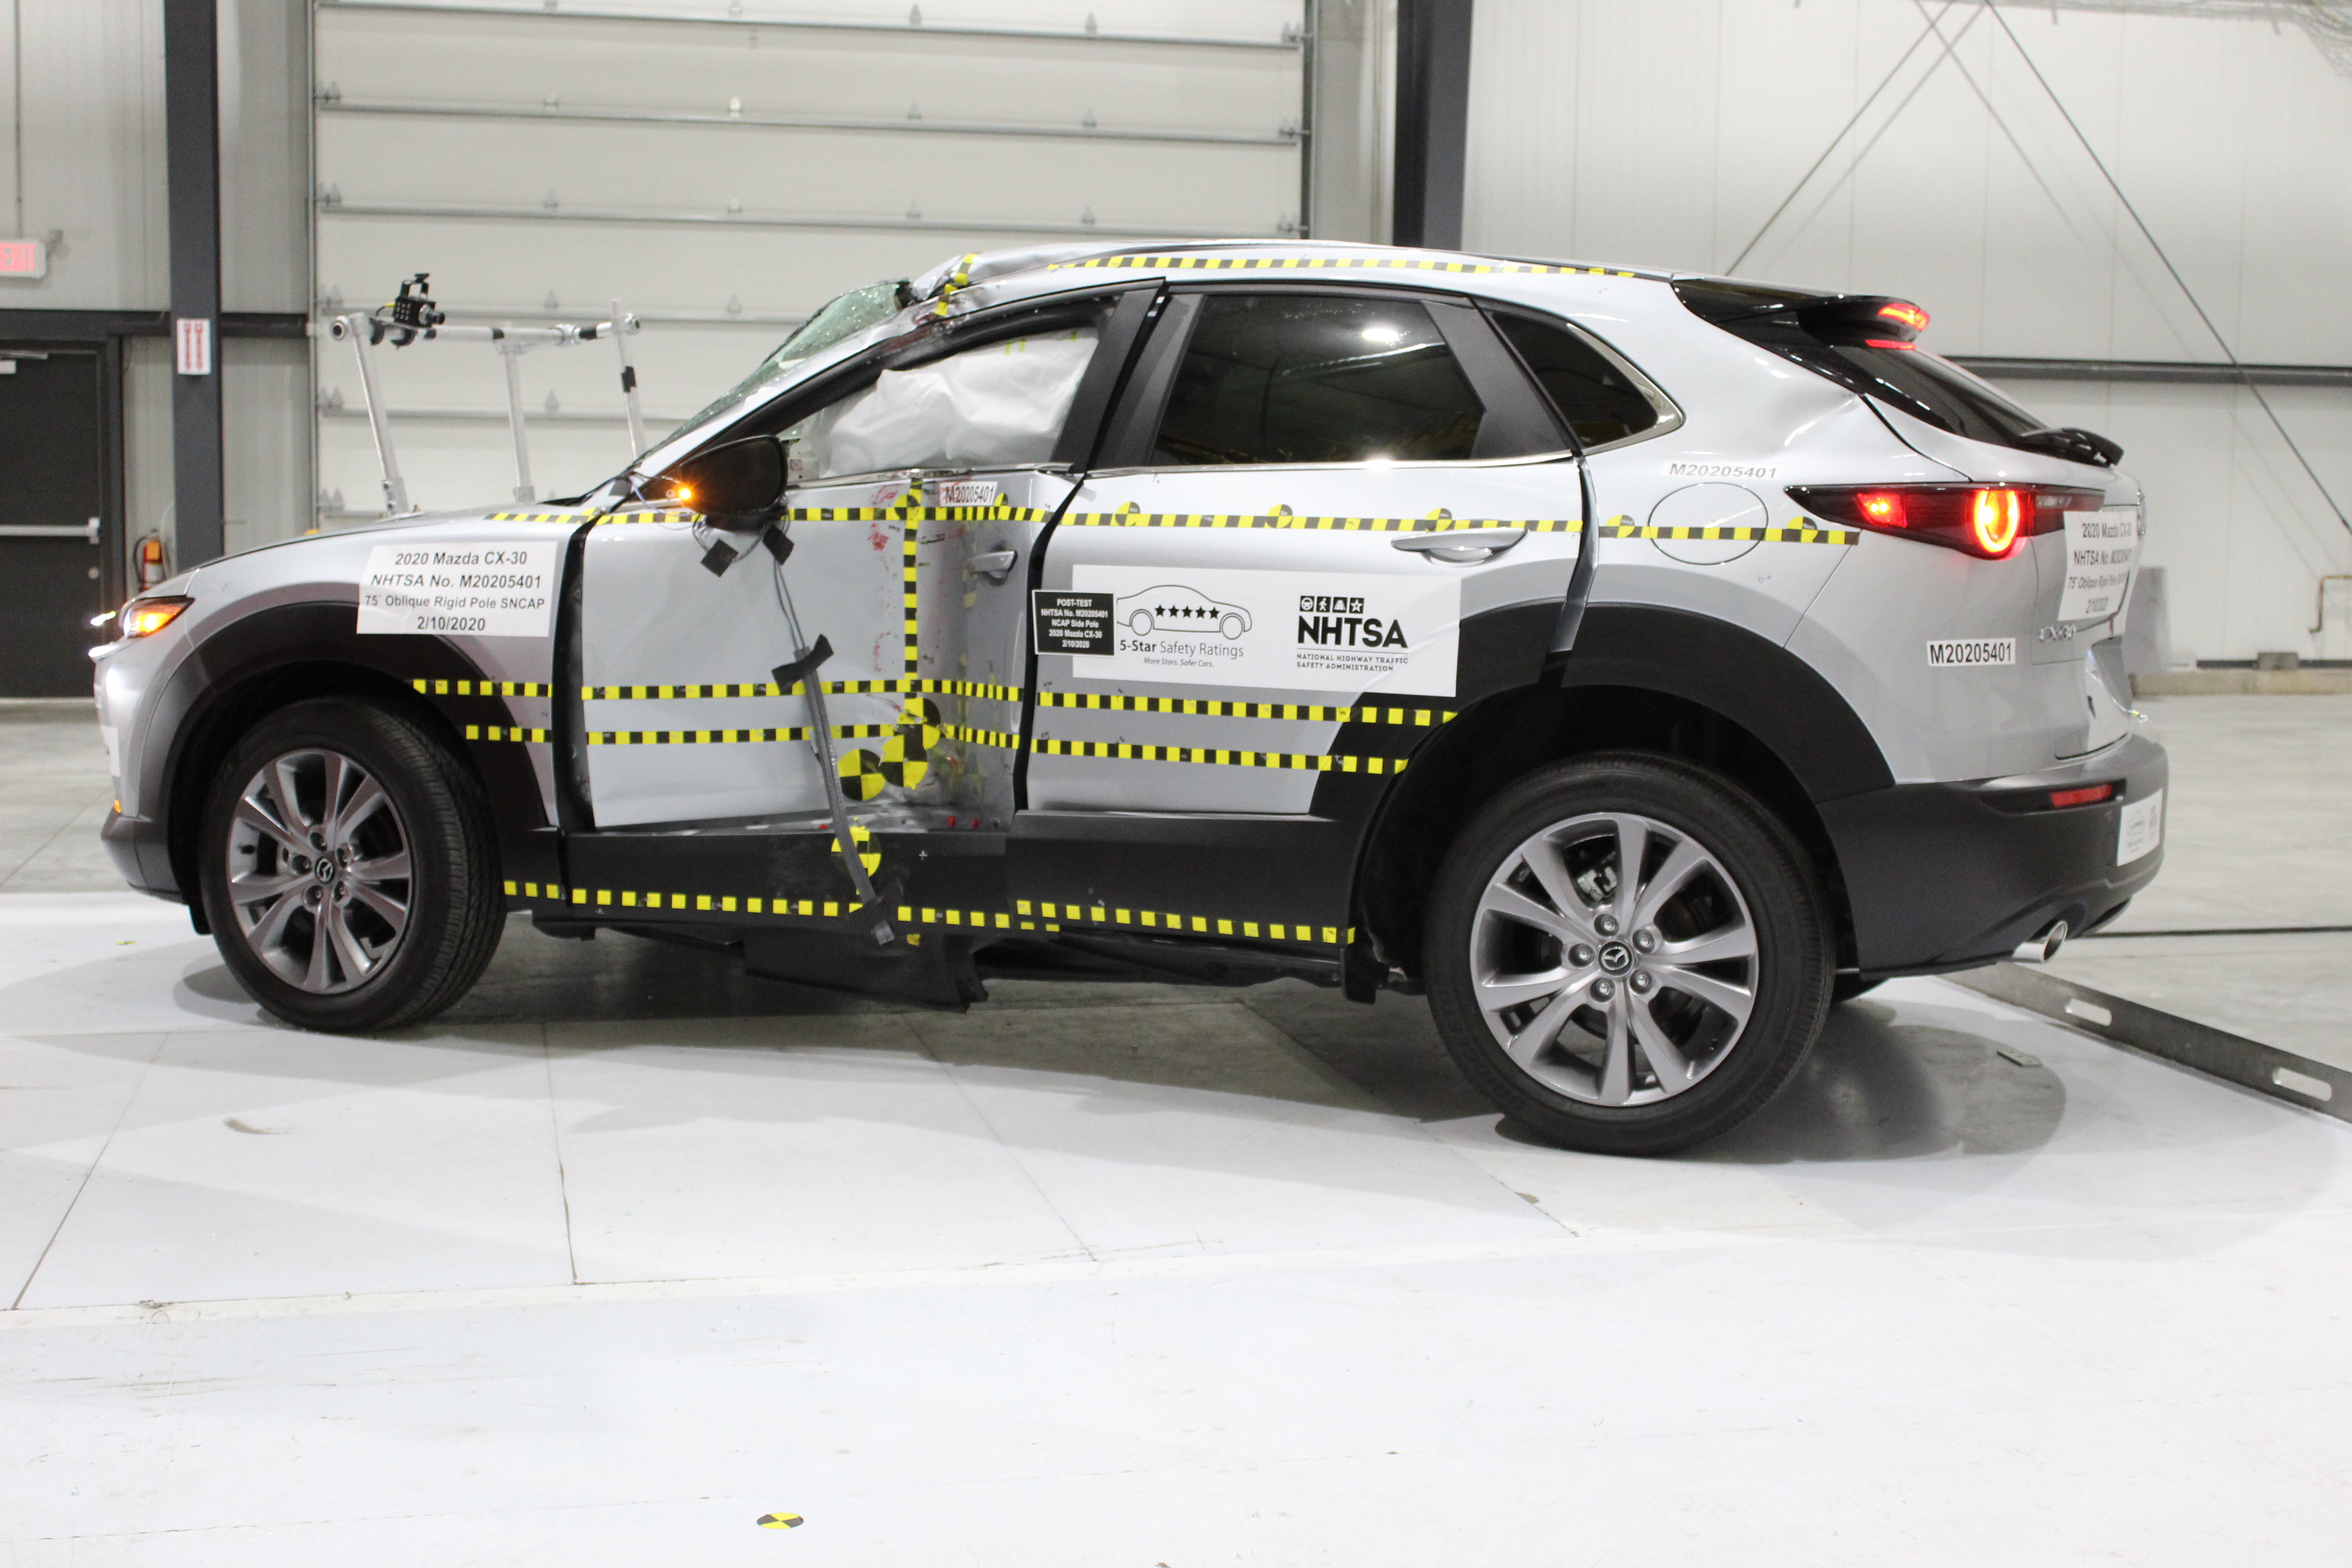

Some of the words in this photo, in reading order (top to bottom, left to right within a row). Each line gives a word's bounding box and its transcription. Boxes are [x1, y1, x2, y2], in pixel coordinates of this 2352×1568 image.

[1669, 463, 1777, 478] M20205401
[945, 485, 994, 504] M20205401
[2082, 523, 2100, 538] 2020
[394, 553, 429, 566] 2020
[433, 552, 479, 565] Mazda
[484, 551, 527, 565] CX-30
[2074, 551, 2099, 565] NHTSA
[370, 574, 424, 587] NHTSA
[429, 575, 454, 587] No.
[459, 575, 541, 588] M20205401
[385, 595, 429, 609] Oblique
[434, 596, 466, 610] Rigid
[470, 598, 496, 608] Pole
[500, 598, 545, 609] SNCAP
[1057, 599, 1092, 607] POST-TEST
[1041, 608, 1062, 617] NHTSA
[1076, 610, 1108, 618] M20205401
[416, 617, 485, 631] 2/10/2020
[1085, 620, 1099, 628] Pole
[1049, 629, 1063, 637] 2020
[1064, 630, 1083, 638] Mazda
[1084, 630, 1102, 638] CX-30
[1298, 615, 1409, 649] NHTSA
[1062, 640, 1090, 649] 2/10/2020
[1120, 640, 1156, 652] 5-Star
[1160, 641, 1196, 657] Safety
[1199, 642, 1244, 659] Ratings
[1297, 653, 1334, 662] NATIONAL
[1929, 642, 2012, 664] M20205401
[1326, 664, 1394, 672] ADMINISTRATION
